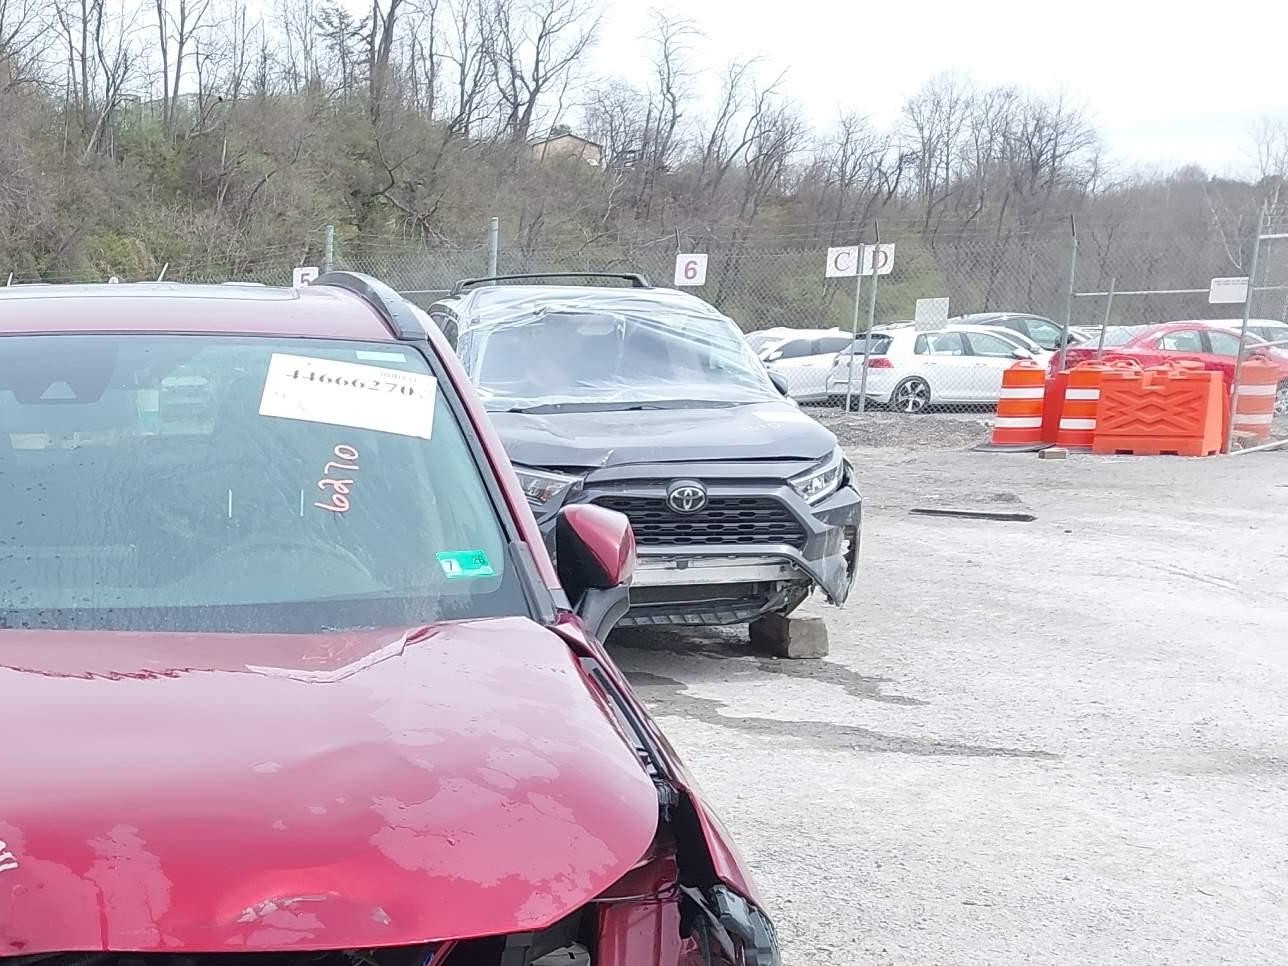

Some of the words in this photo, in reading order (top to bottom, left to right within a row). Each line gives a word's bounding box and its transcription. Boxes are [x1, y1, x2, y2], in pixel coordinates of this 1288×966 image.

[684, 260, 698, 280] 6
[834, 251, 851, 272] C
[872, 250, 888, 270] D
[300, 272, 311, 287] 5
[286, 369, 415, 397] 44666270
[313, 444, 360, 512] 6270
